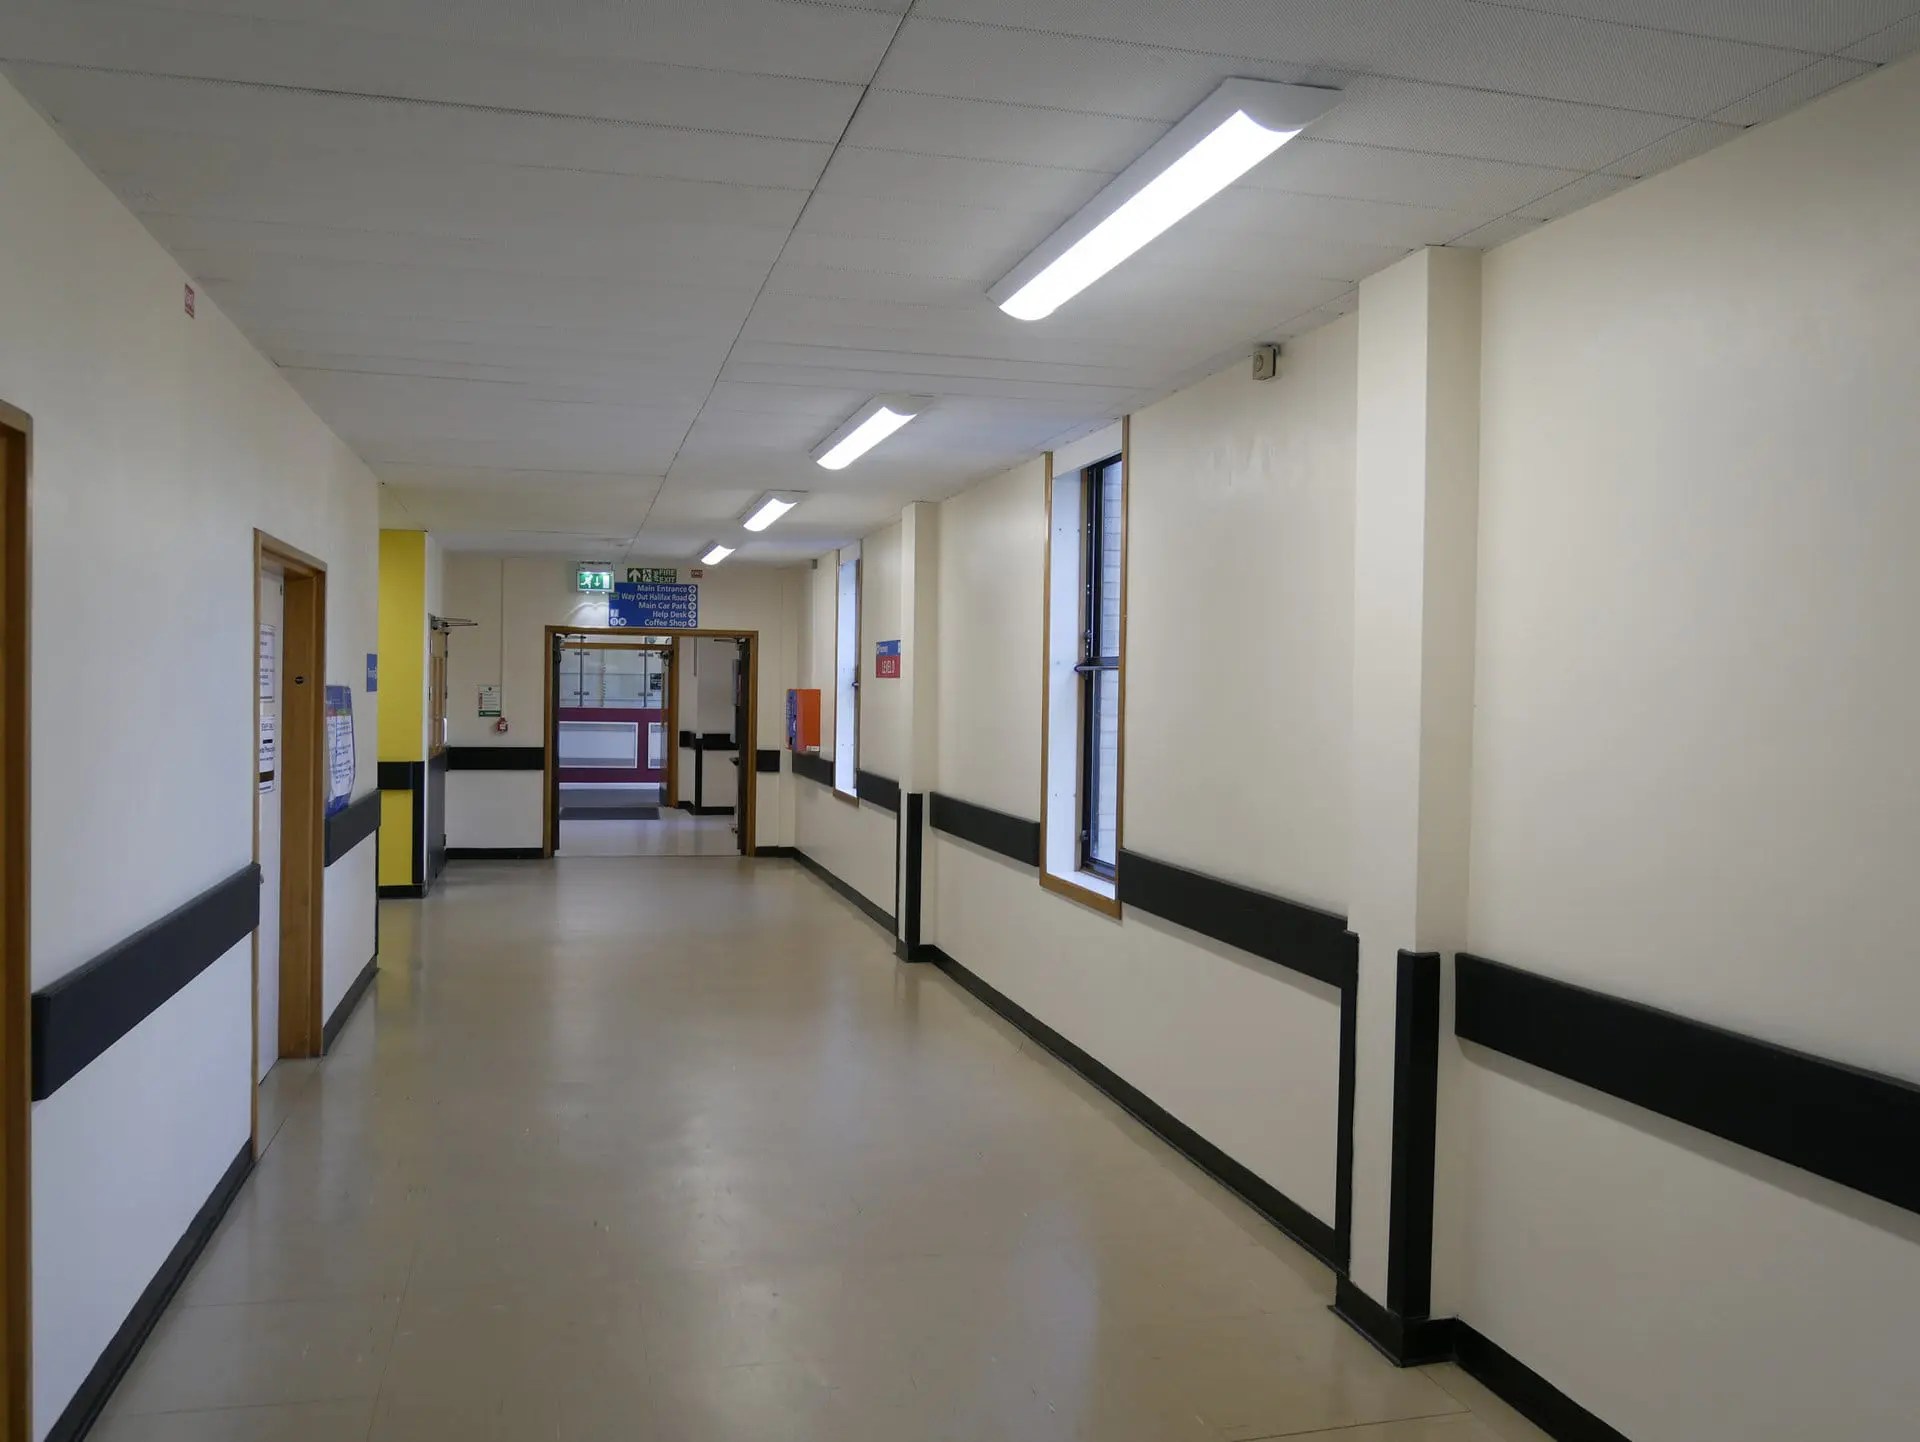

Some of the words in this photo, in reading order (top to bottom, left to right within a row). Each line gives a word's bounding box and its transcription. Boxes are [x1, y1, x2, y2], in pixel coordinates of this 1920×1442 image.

[637, 584, 655, 592] Main
[657, 584, 687, 592] Entrance
[621, 593, 635, 601] Way
[671, 593, 687, 601] Road
[652, 610, 669, 618] Help
[670, 610, 687, 618] Desk
[644, 618, 668, 626] Coffee
[669, 619, 687, 627] Shop
